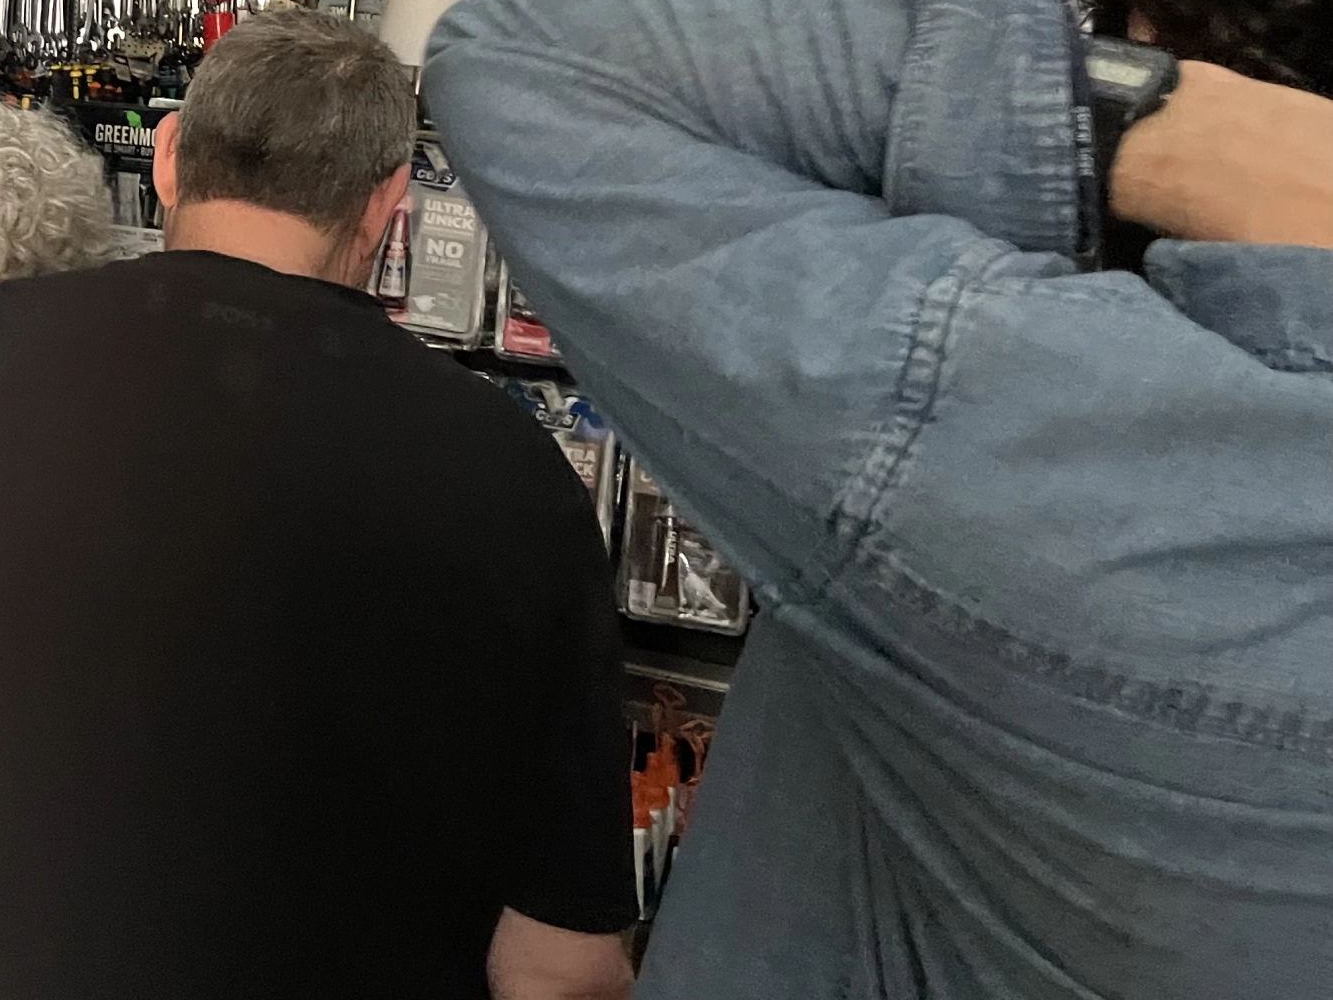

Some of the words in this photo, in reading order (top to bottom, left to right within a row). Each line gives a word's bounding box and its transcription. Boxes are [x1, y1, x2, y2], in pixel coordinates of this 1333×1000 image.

[424, 199, 476, 218] ULTRA
[423, 212, 474, 231] UNICK
[426, 237, 464, 259] NO
[565, 447, 596, 463] TRA
